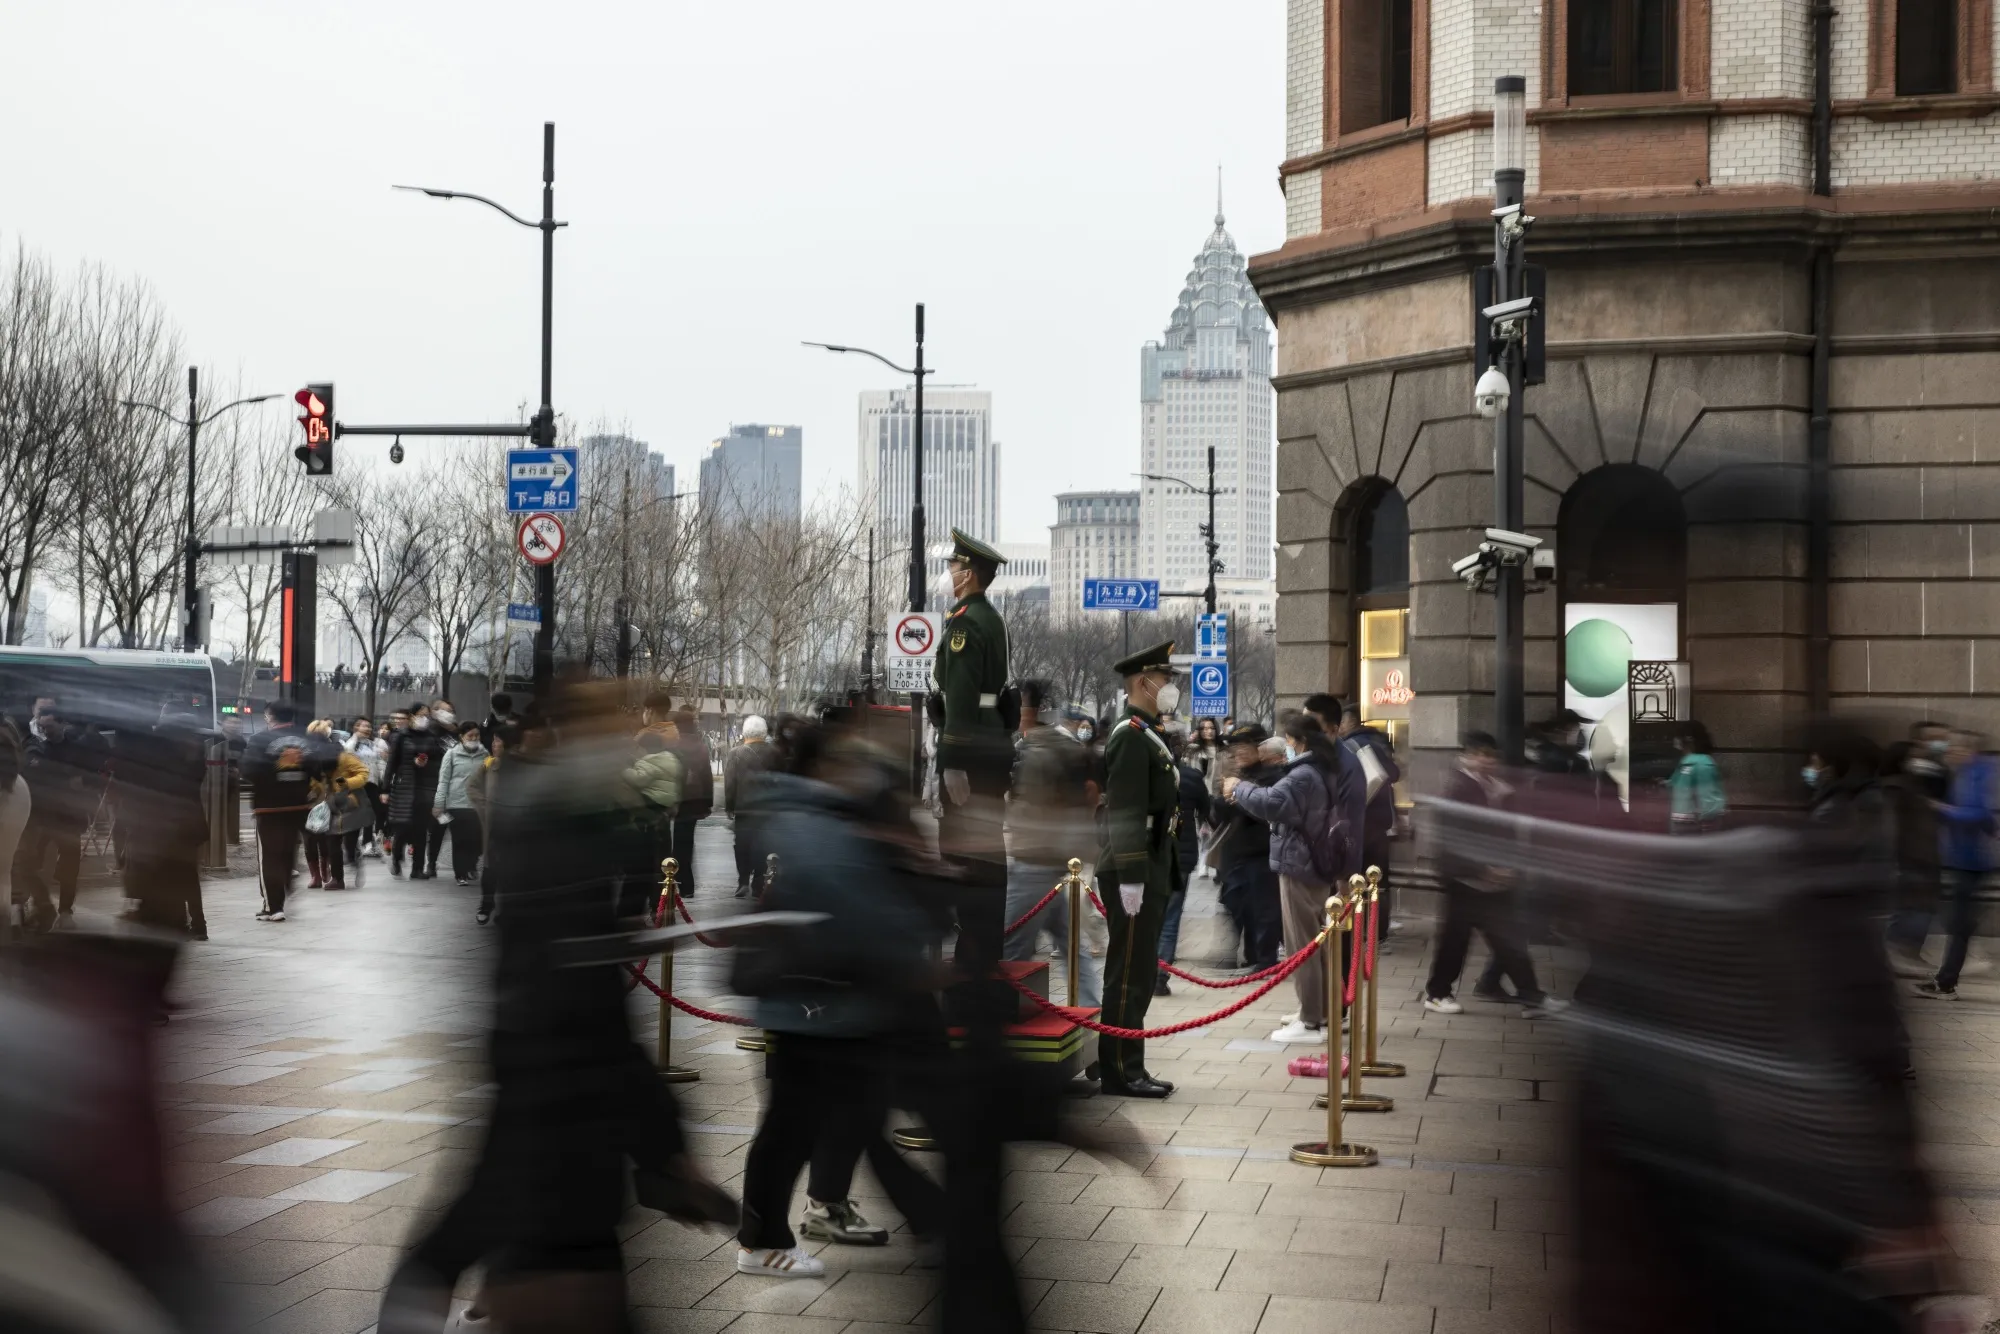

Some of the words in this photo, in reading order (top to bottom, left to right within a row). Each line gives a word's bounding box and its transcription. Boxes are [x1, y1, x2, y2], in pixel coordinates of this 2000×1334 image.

[518, 465, 547, 476] 单行道
[514, 490, 570, 508] 下一路口
[1101, 585, 1137, 597] 九江路
[897, 659, 932, 668] 大型号牌
[897, 670, 931, 679] 小型号牌
